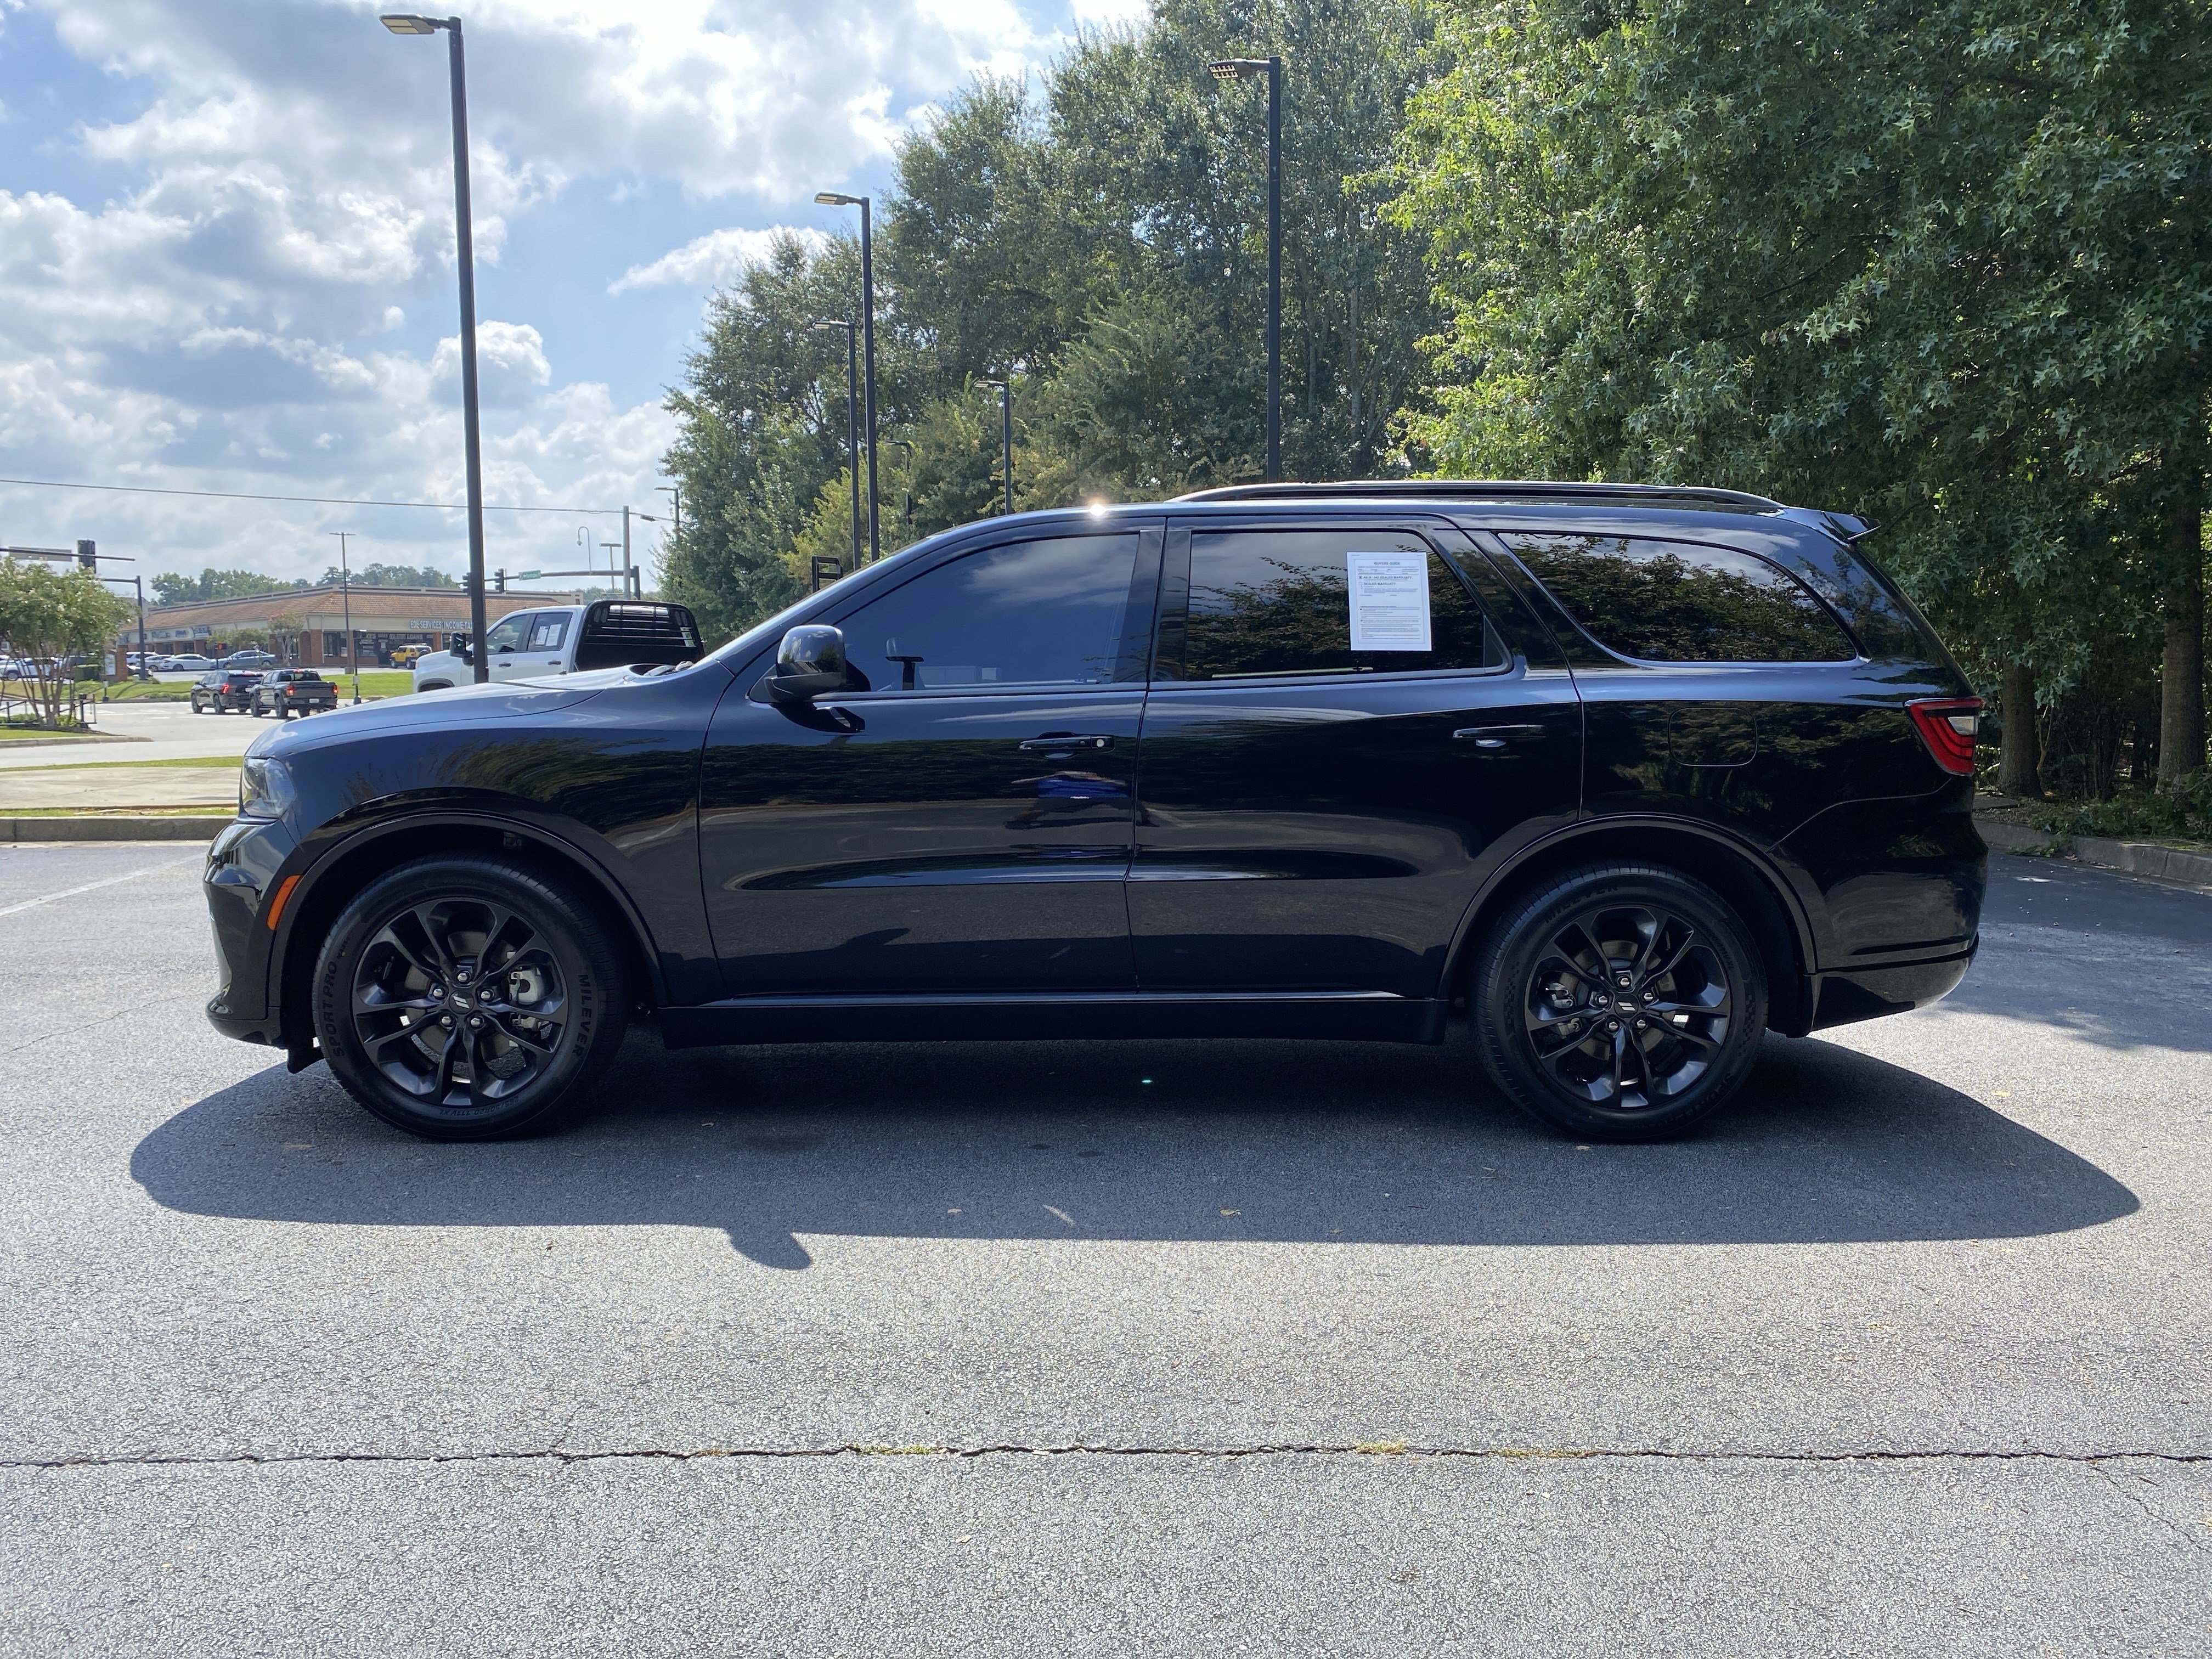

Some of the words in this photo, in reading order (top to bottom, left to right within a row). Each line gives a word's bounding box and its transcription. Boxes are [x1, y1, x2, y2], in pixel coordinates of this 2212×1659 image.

[420, 620, 442, 629] SERVICES
[443, 621, 464, 629] INCOME
[323, 961, 337, 997] PRO
[322, 1000, 346, 1057] SPORT
[572, 974, 592, 1057] MILEVER
